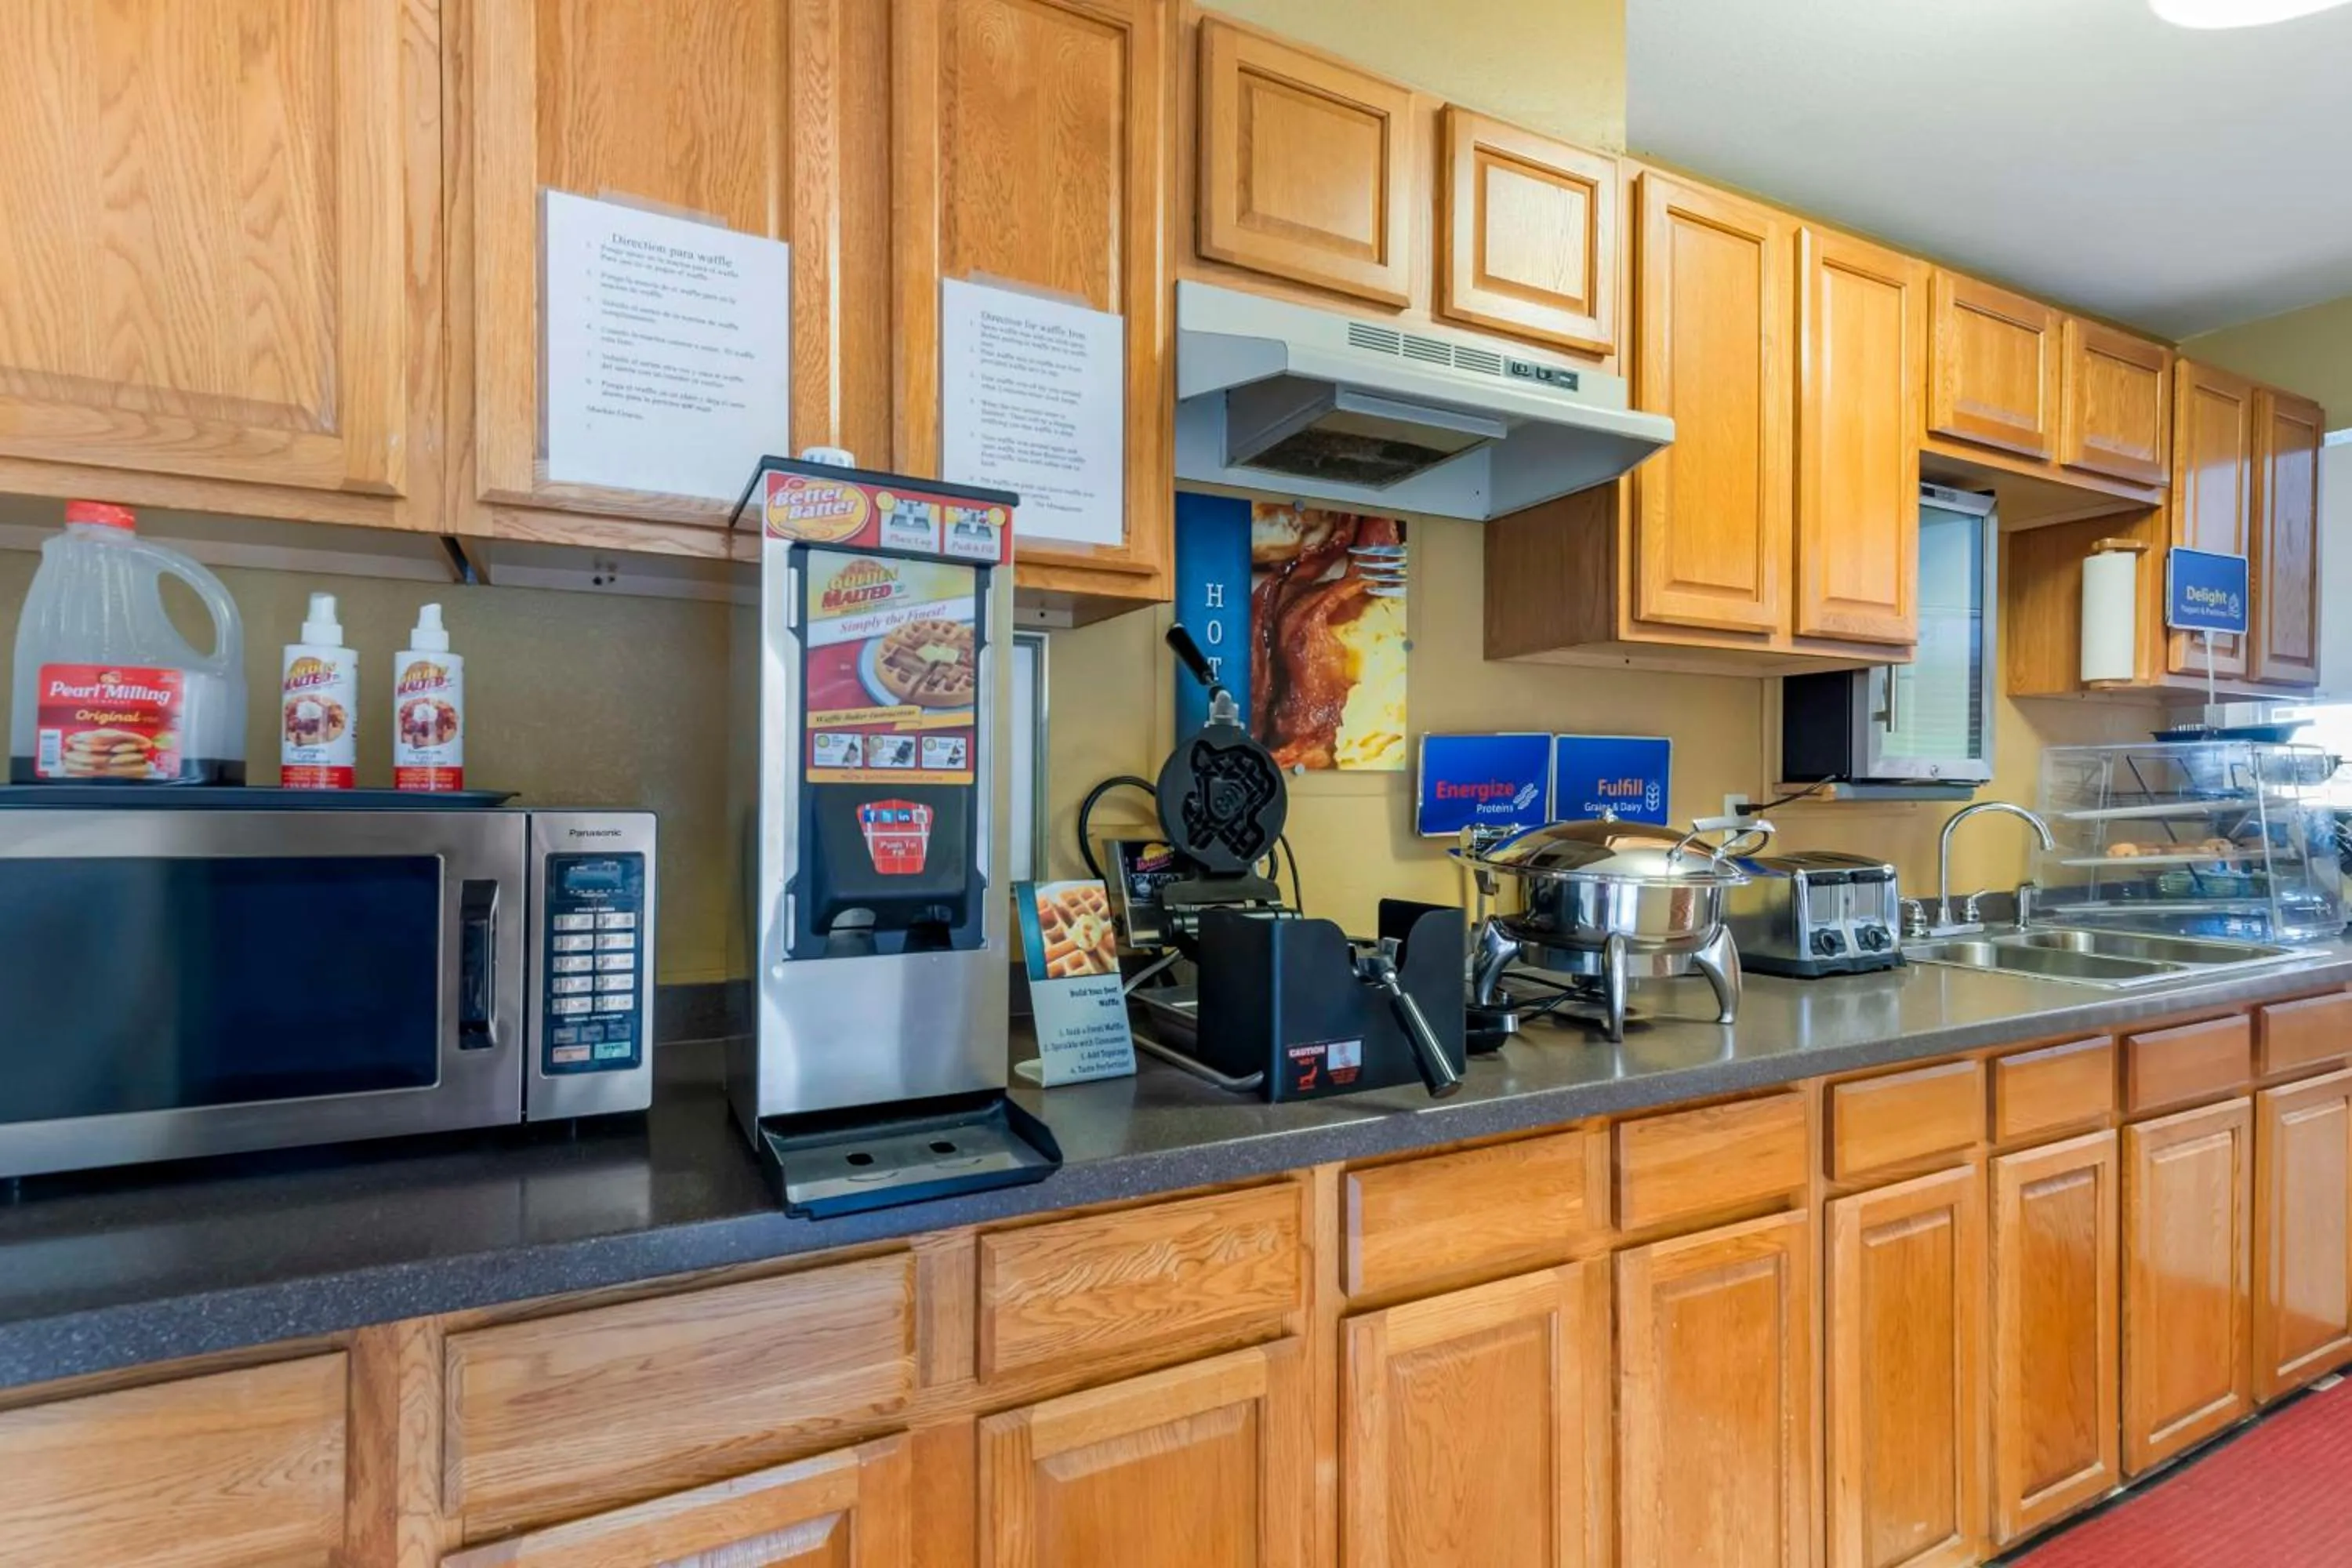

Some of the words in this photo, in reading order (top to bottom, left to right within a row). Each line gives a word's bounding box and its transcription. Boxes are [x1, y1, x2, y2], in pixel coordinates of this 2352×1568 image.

[612, 233, 665, 254] Direction
[670, 248, 693, 261] para
[698, 251, 732, 267] waffle
[980, 310, 1022, 327] Direction
[1024, 319, 1037, 331] for
[1041, 323, 1066, 336] waffle
[822, 583, 892, 608] MALTED
[2186, 586, 2227, 607] Delight
[840, 615, 882, 633] Simply
[885, 612, 904, 625] the
[1205, 583, 1224, 681] HOT
[49, 681, 100, 698] Pearl
[102, 684, 172, 706] Milling
[75, 709, 140, 725] Original
[1436, 779, 1514, 802] Energize
[1598, 778, 1643, 797] Fulfill
[1476, 803, 1514, 814] Proteins
[1613, 803, 1618, 811] &
[1620, 802, 1642, 815] Dairy
[568, 829, 622, 837] Panasonic
[1098, 997, 1120, 1007] Waffle
[1288, 1044, 1326, 1058] CAUTION
